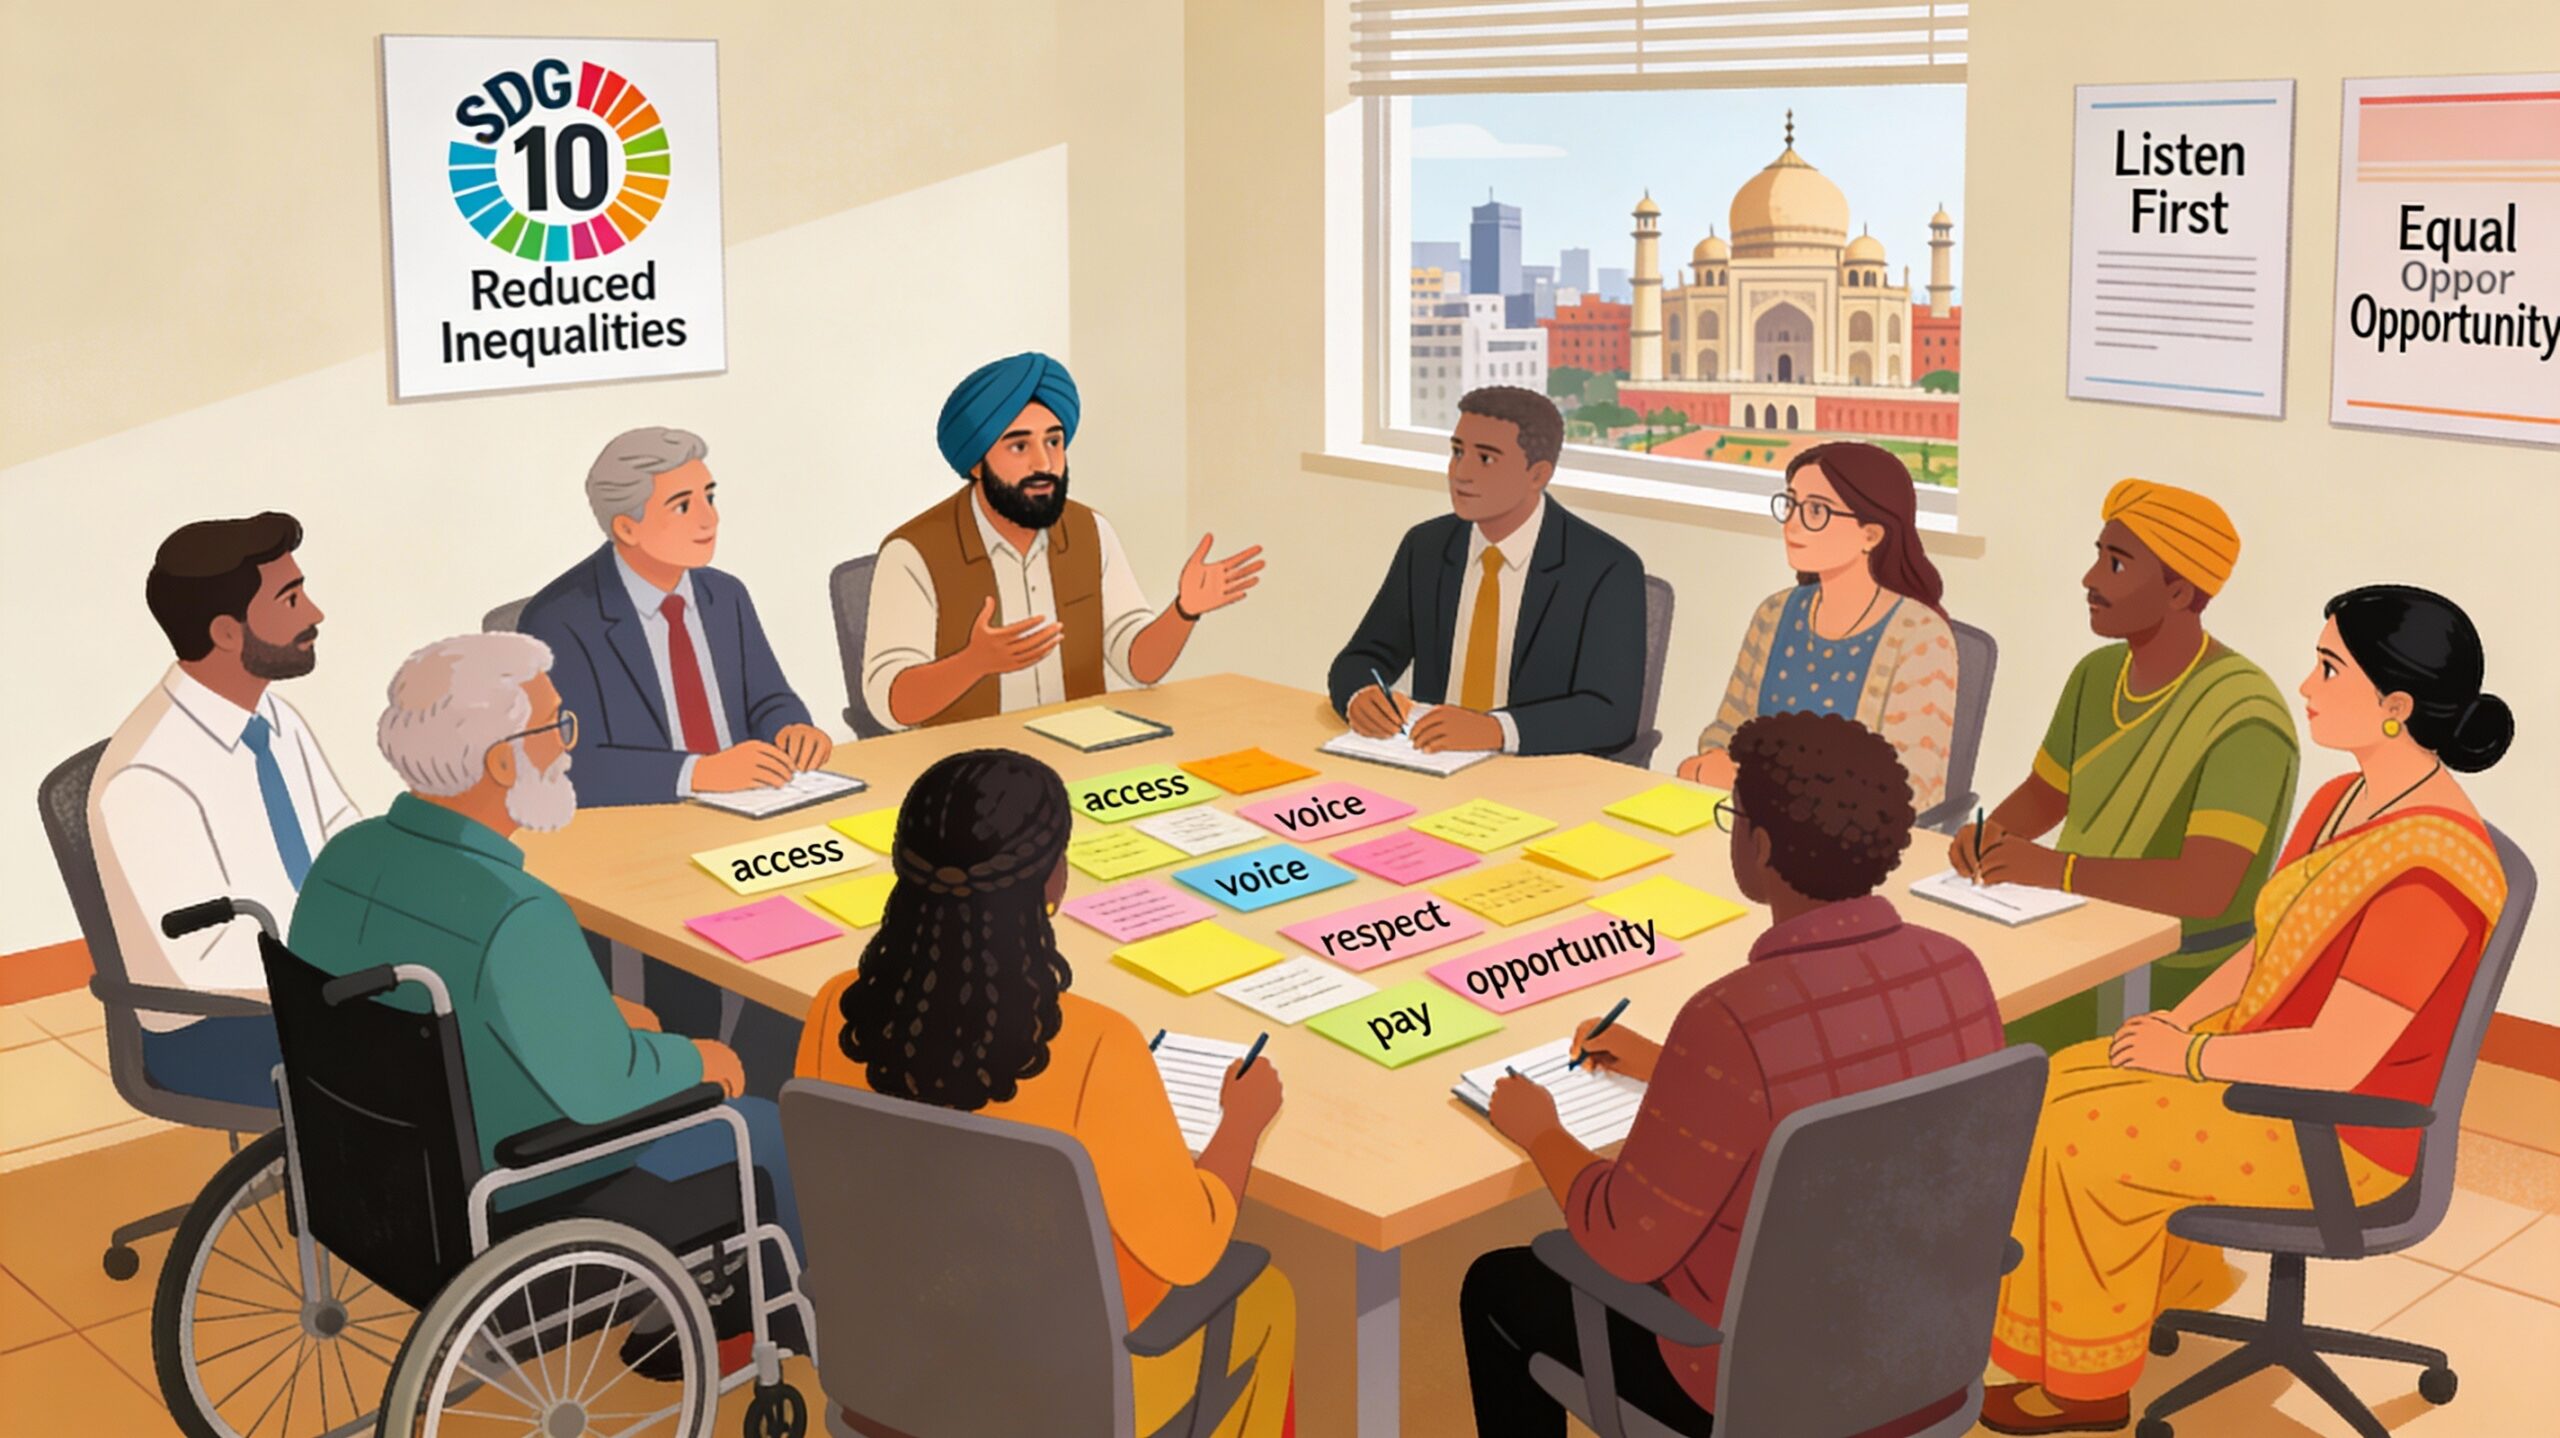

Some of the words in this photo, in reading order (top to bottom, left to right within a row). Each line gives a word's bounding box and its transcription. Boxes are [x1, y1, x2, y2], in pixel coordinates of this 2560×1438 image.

[457, 60, 571, 143] SDG
[514, 124, 608, 211] 10
[2116, 130, 2244, 175] Listen
[2133, 189, 2228, 234] First
[2400, 203, 2516, 263] Equal
[472, 261, 654, 310] Reduced
[2402, 261, 2514, 302] Oppor
[443, 312, 686, 367] Inequalities
[2351, 294, 2560, 361] Opportunity
[1084, 776, 1188, 811] access
[1275, 797, 1365, 830] voice
[732, 841, 843, 881] access
[1216, 861, 1308, 895] voice
[1321, 902, 1450, 955] respect
[1467, 920, 1654, 999] opportunity
[1368, 1003, 1431, 1050] pay
